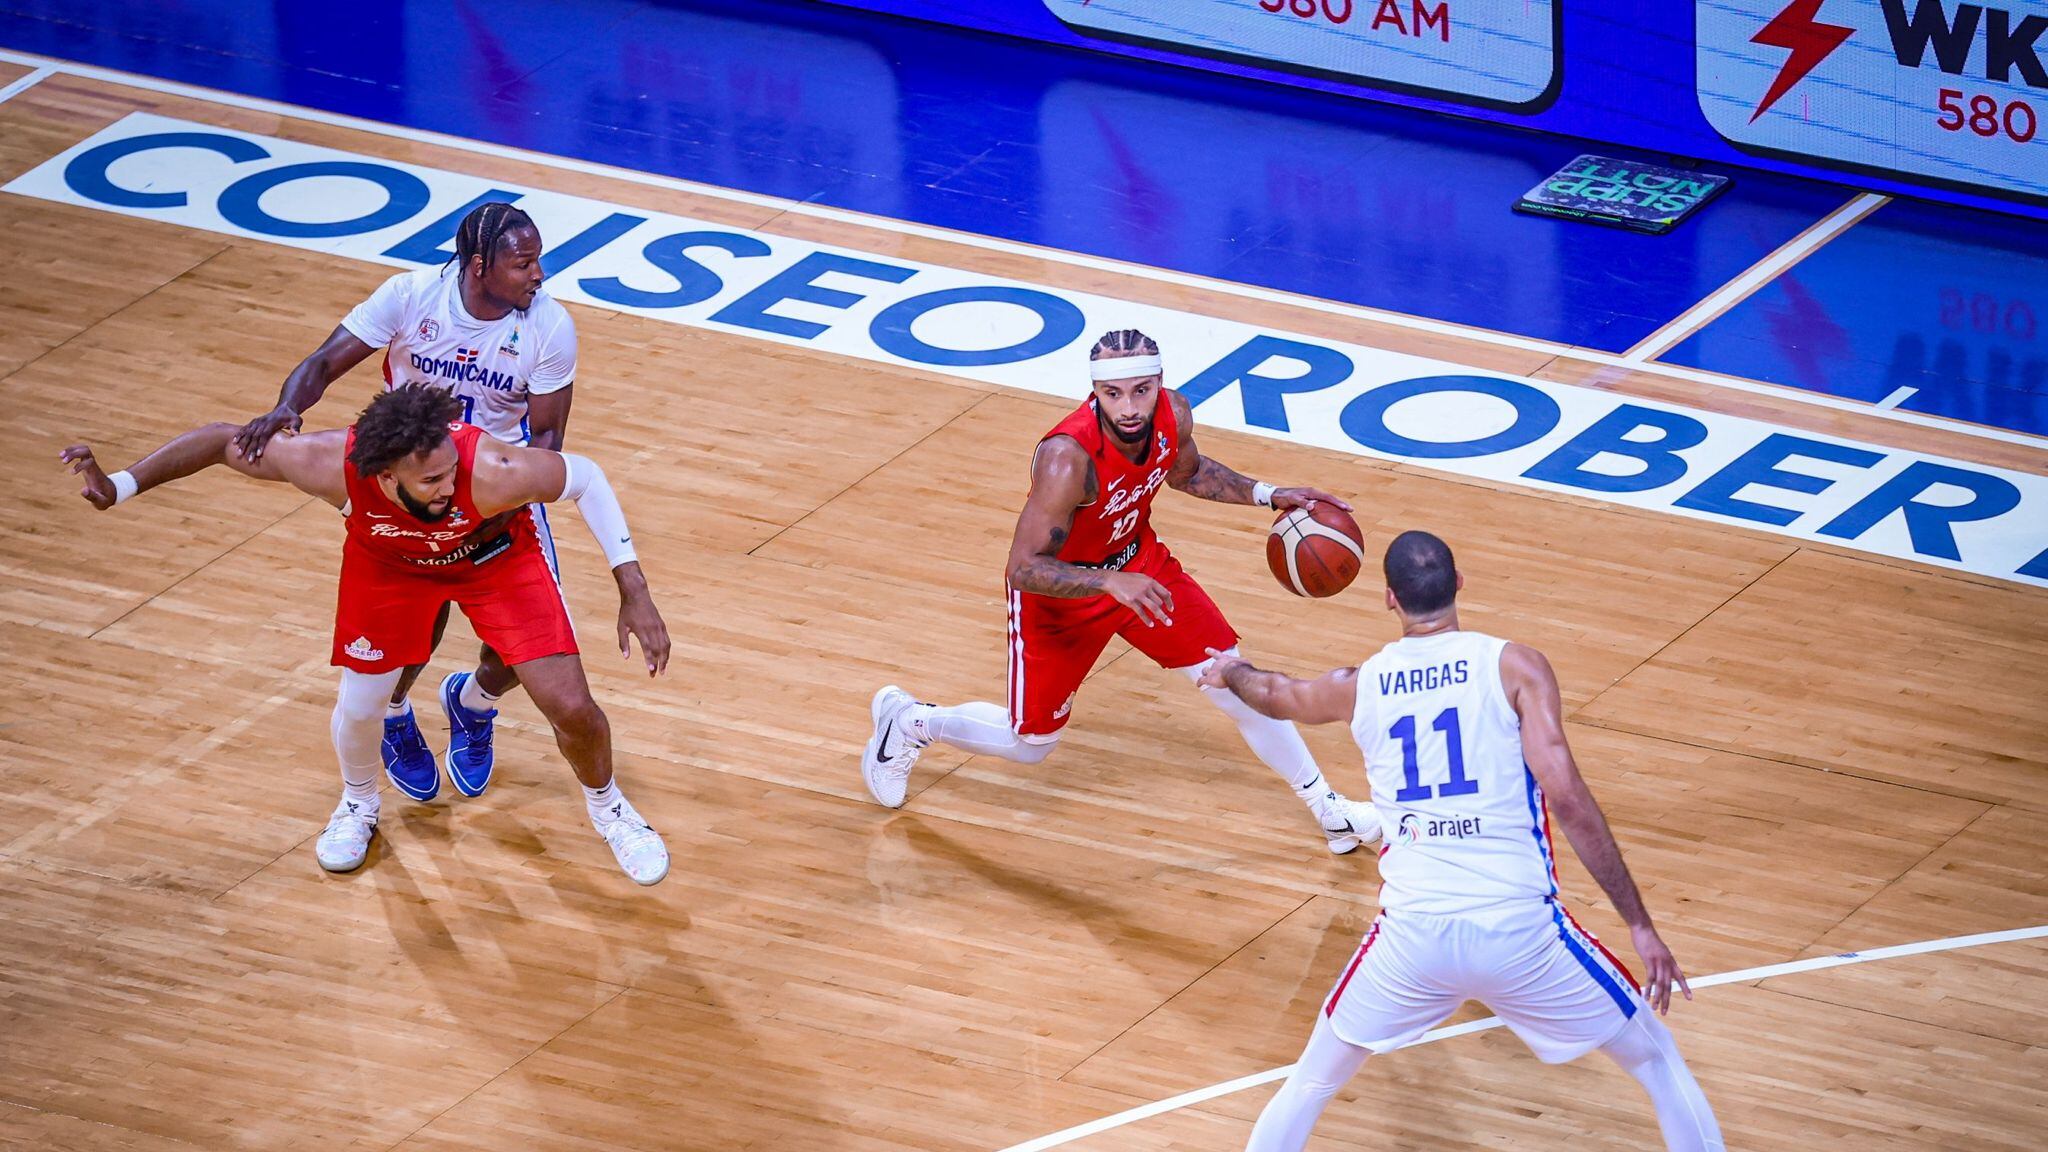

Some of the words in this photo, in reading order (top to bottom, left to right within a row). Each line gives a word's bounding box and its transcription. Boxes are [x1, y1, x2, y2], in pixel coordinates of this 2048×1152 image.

[1371, 0, 1449, 42] AM
[1937, 88, 2036, 143] 580
[64, 132, 1086, 367] COLISEO
[1178, 334, 2048, 578] ROBER
[410, 353, 514, 392] DOMINCANA
[1106, 509, 1139, 545] 10
[1379, 660, 1468, 695] VARGAS
[1389, 707, 1479, 802] 11
[1428, 814, 1481, 839] arajet
